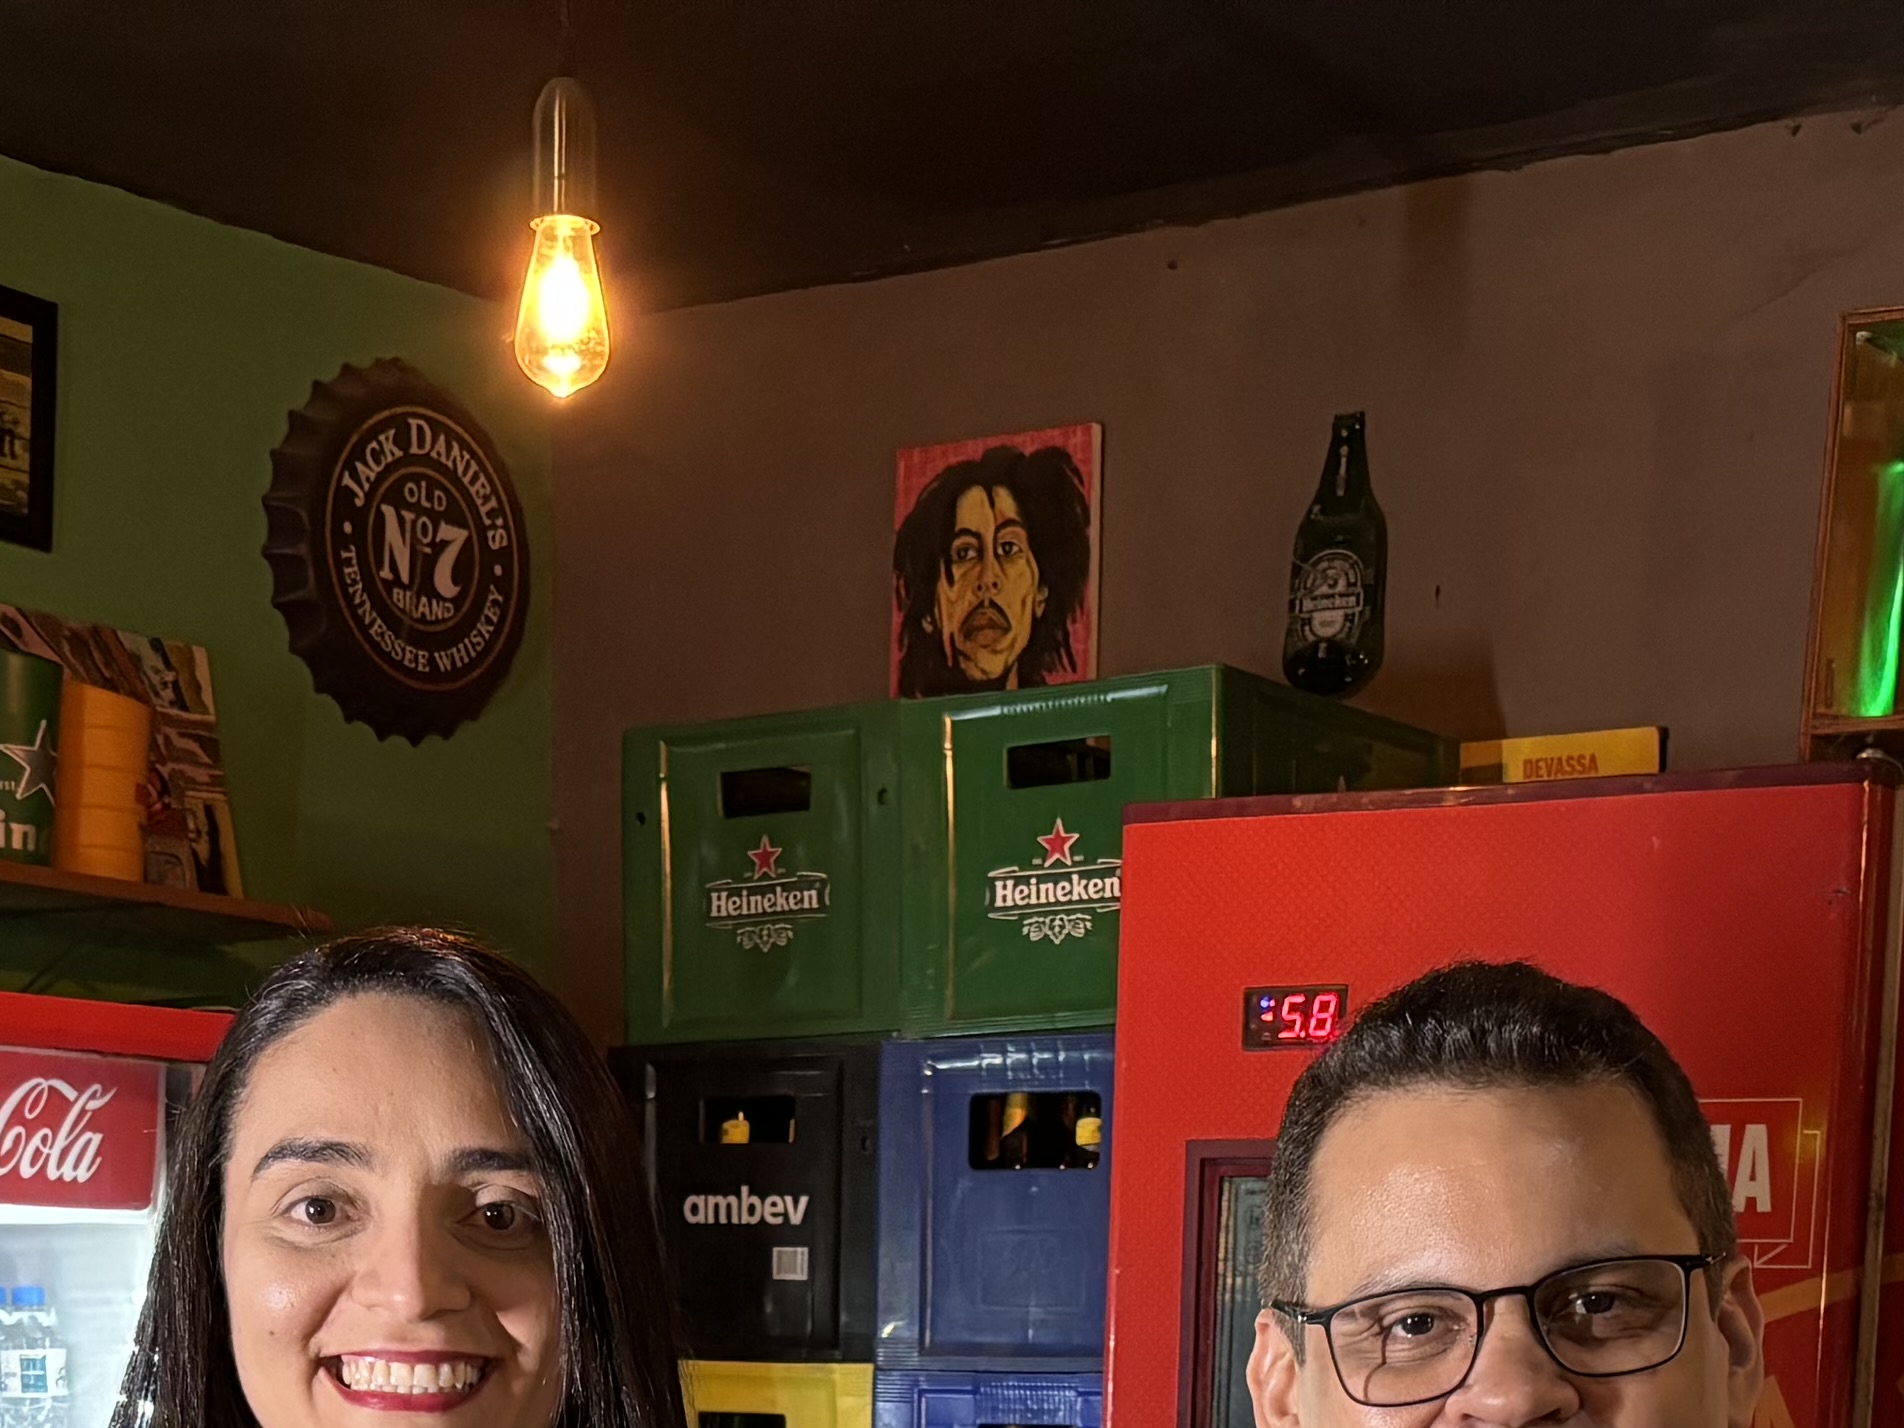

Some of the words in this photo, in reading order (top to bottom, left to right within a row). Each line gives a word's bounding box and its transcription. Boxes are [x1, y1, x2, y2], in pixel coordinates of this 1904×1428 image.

[341, 427, 404, 508] JACK
[406, 417, 509, 551] DANIEL'S
[403, 480, 447, 512] OLD
[340, 544, 431, 673] TENNESSEE
[433, 584, 505, 673] WHISKEY
[392, 587, 455, 622] BRAND
[1522, 751, 1599, 780] DEVASSA
[709, 886, 820, 918] Heineken
[994, 873, 1122, 908] Heineken
[1277, 992, 1339, 1040] 5.8
[683, 1184, 810, 1226] ambev
